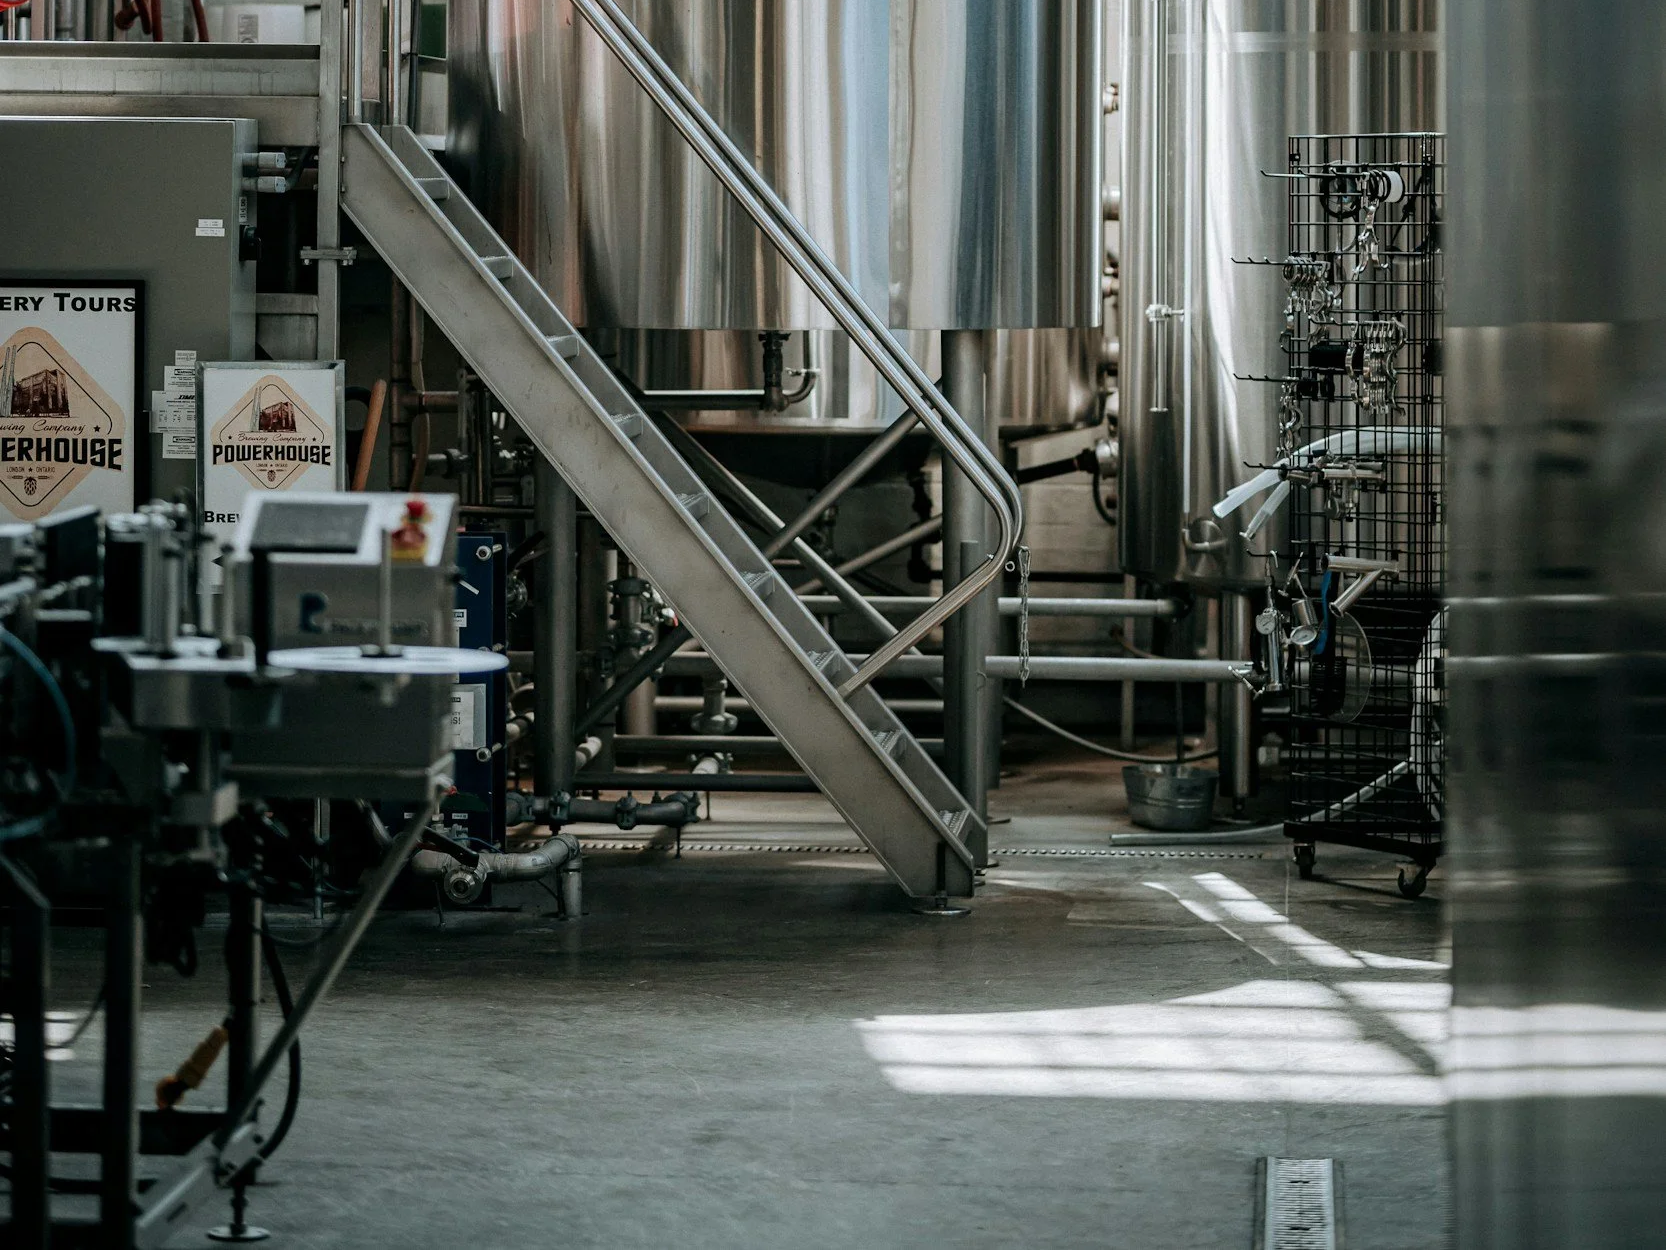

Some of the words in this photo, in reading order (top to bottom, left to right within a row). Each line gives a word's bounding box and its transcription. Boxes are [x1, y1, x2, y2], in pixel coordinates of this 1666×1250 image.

[53, 293, 136, 312] TOURS
[33, 419, 87, 435] Company
[213, 445, 331, 466] POWERHOUSE
